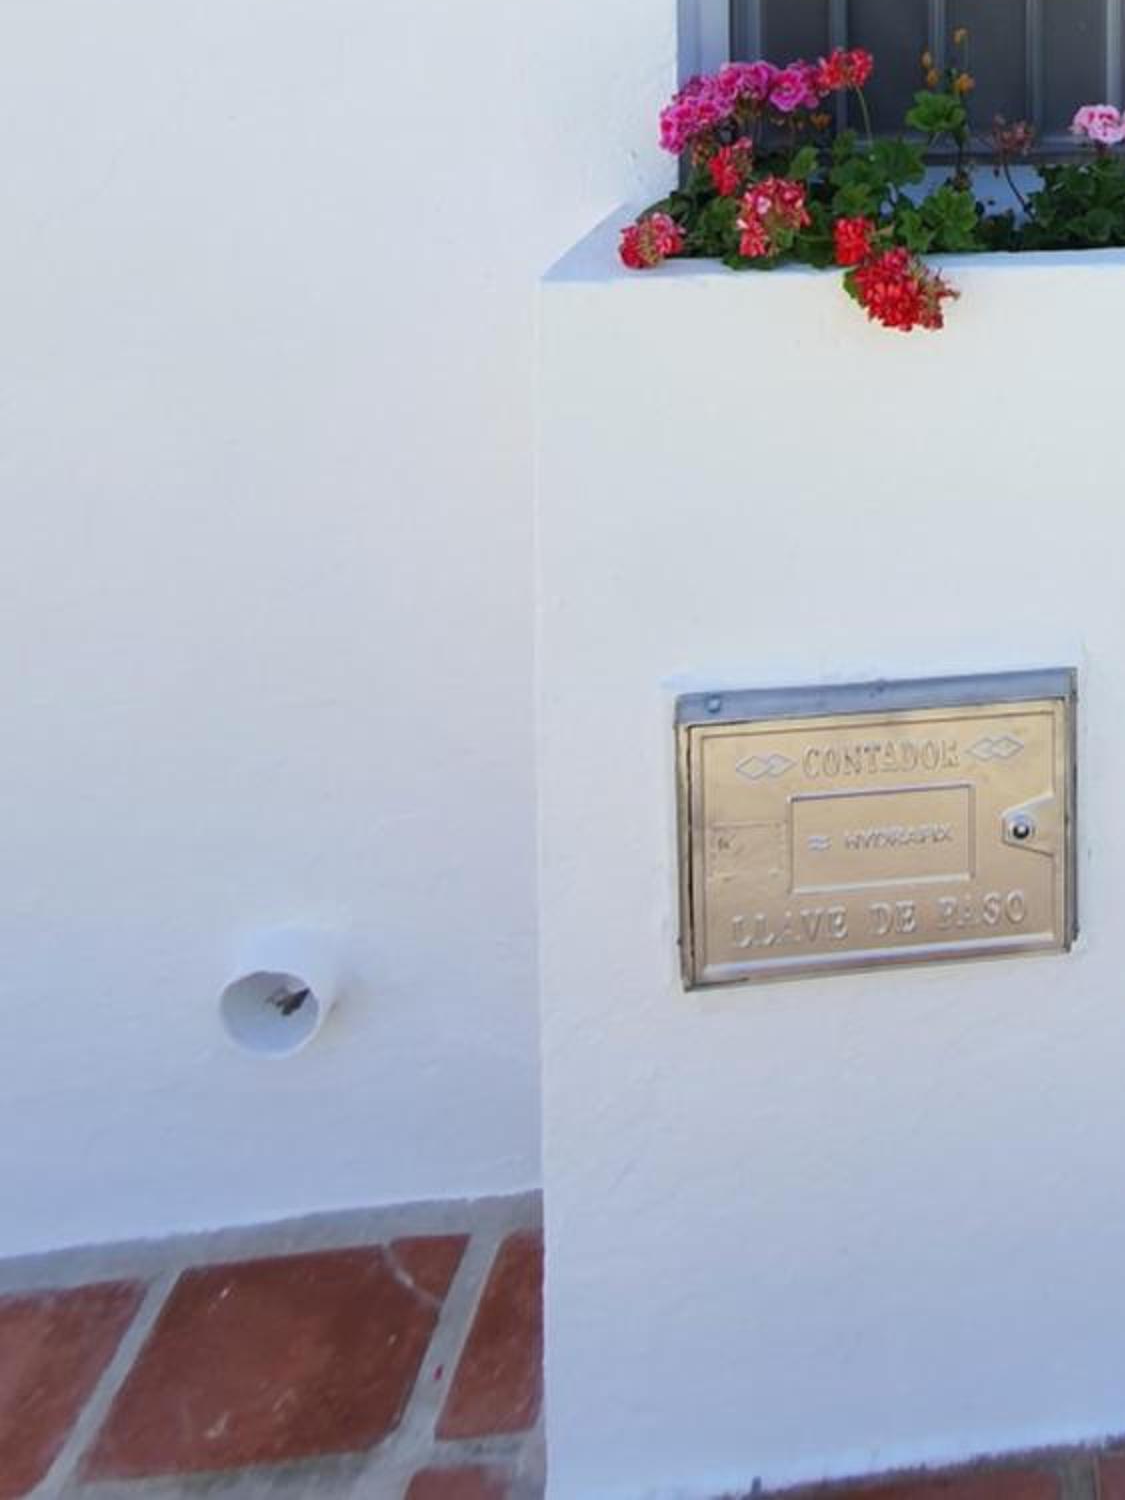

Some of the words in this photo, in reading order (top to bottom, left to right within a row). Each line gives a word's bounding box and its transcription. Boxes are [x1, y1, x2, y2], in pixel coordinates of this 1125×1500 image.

[731, 904, 850, 949] LLAVE
[868, 899, 919, 937] DE
[936, 890, 1029, 930] PASO
